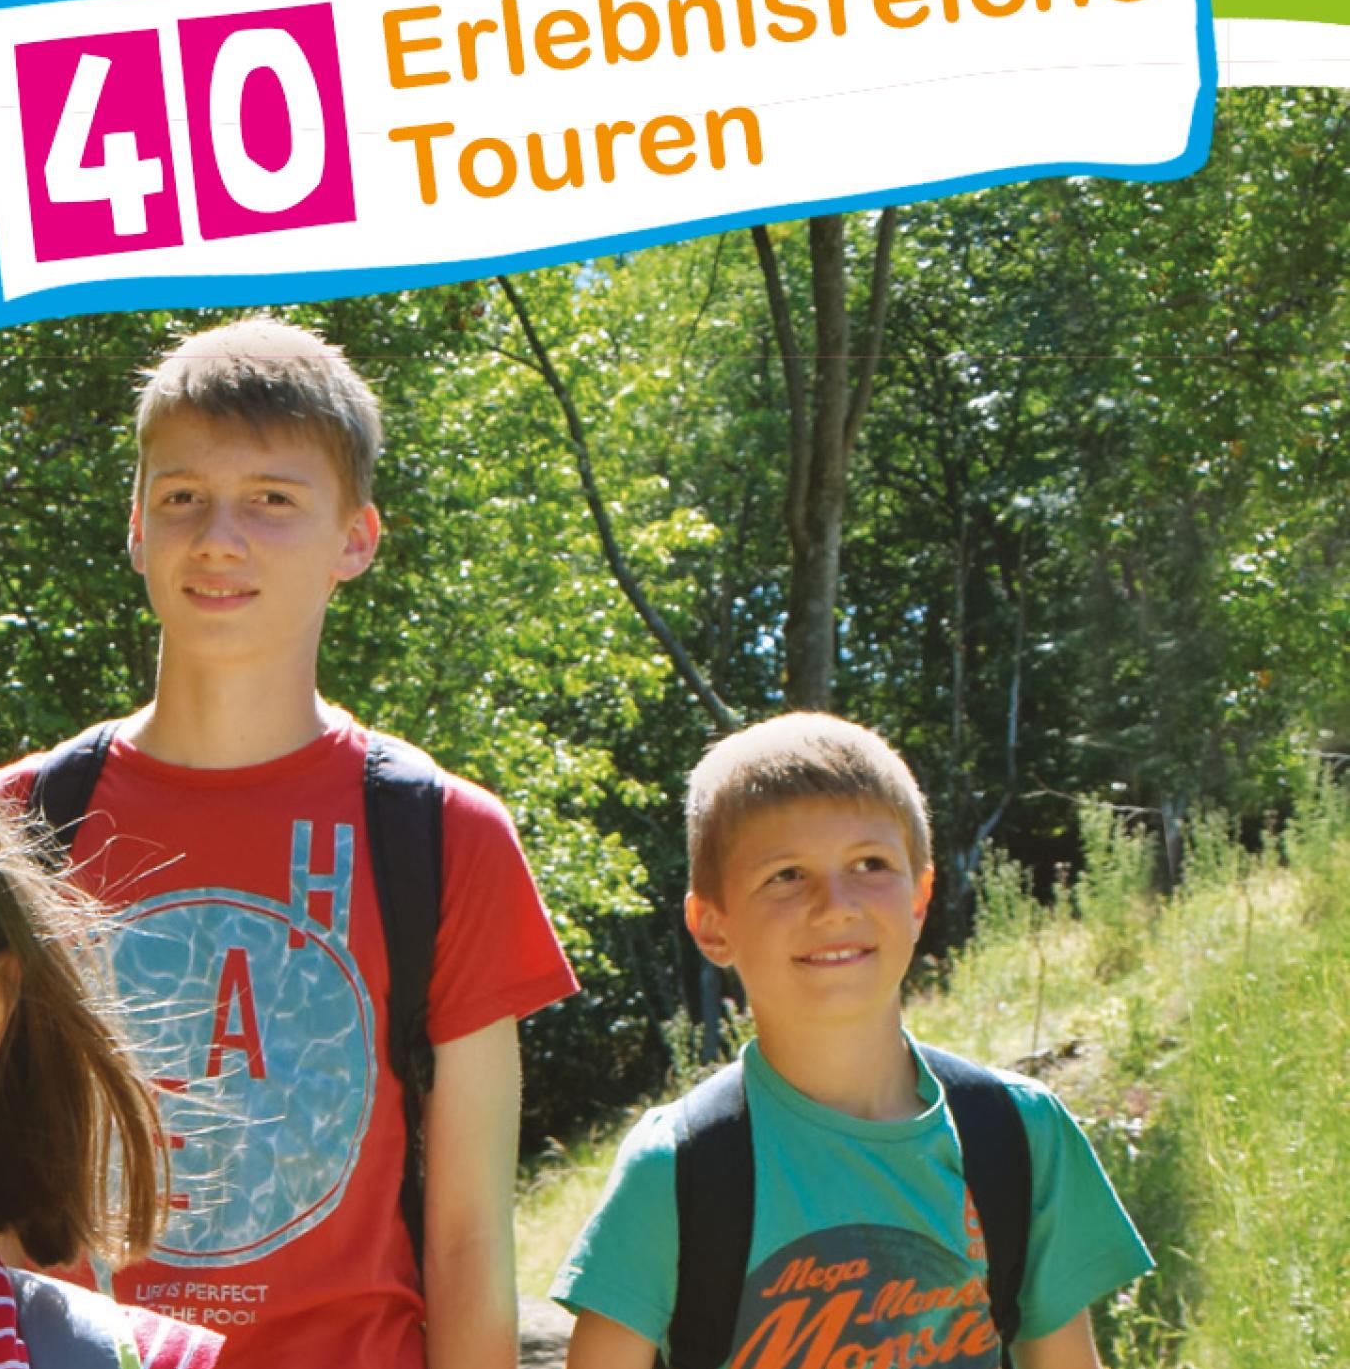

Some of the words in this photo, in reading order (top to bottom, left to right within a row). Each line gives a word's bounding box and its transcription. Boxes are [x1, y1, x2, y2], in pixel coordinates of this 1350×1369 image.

[761, 1255, 869, 1298] Mega
[184, 1281, 269, 1304] PERFECT
[157, 1303, 198, 1323] THE
